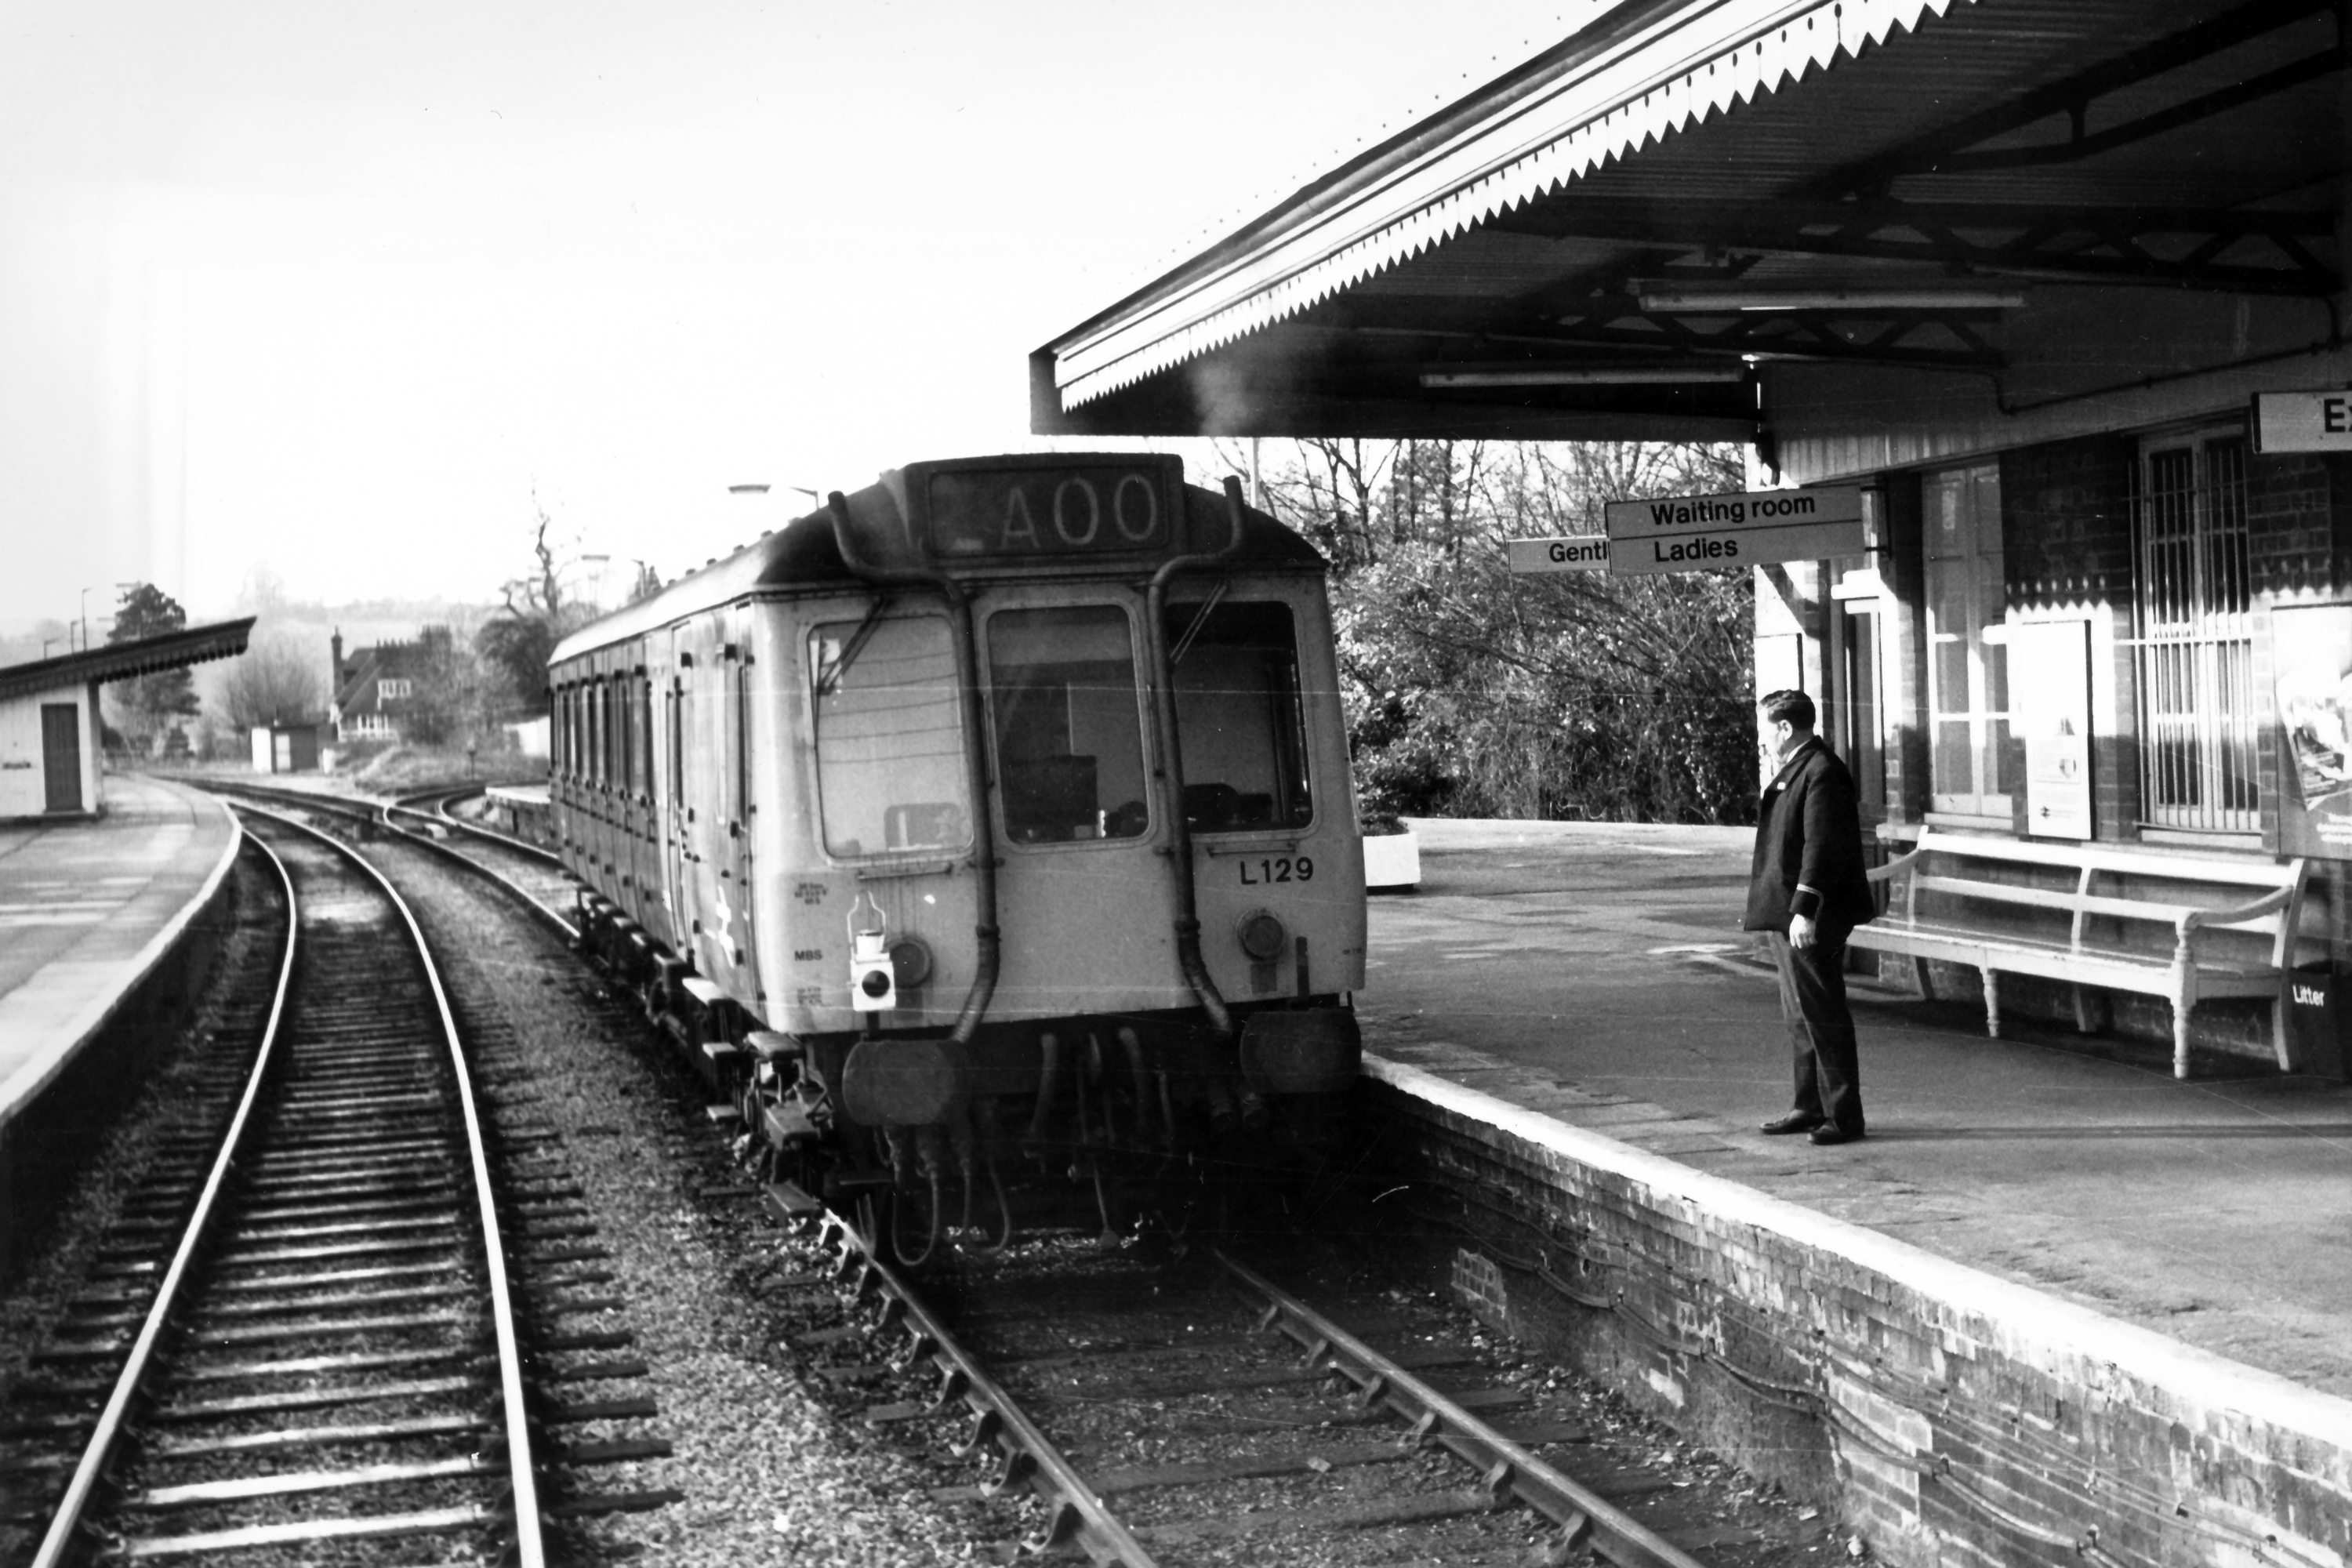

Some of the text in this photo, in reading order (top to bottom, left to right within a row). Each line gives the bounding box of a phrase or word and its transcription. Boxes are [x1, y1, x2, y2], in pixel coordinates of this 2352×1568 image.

[2324, 398, 2352, 433] E
[1650, 495, 1816, 525] Waiting room
[1654, 539, 1738, 562] Ladies
[1240, 857, 1313, 884] L129
[2292, 983, 2325, 1007] Litter
